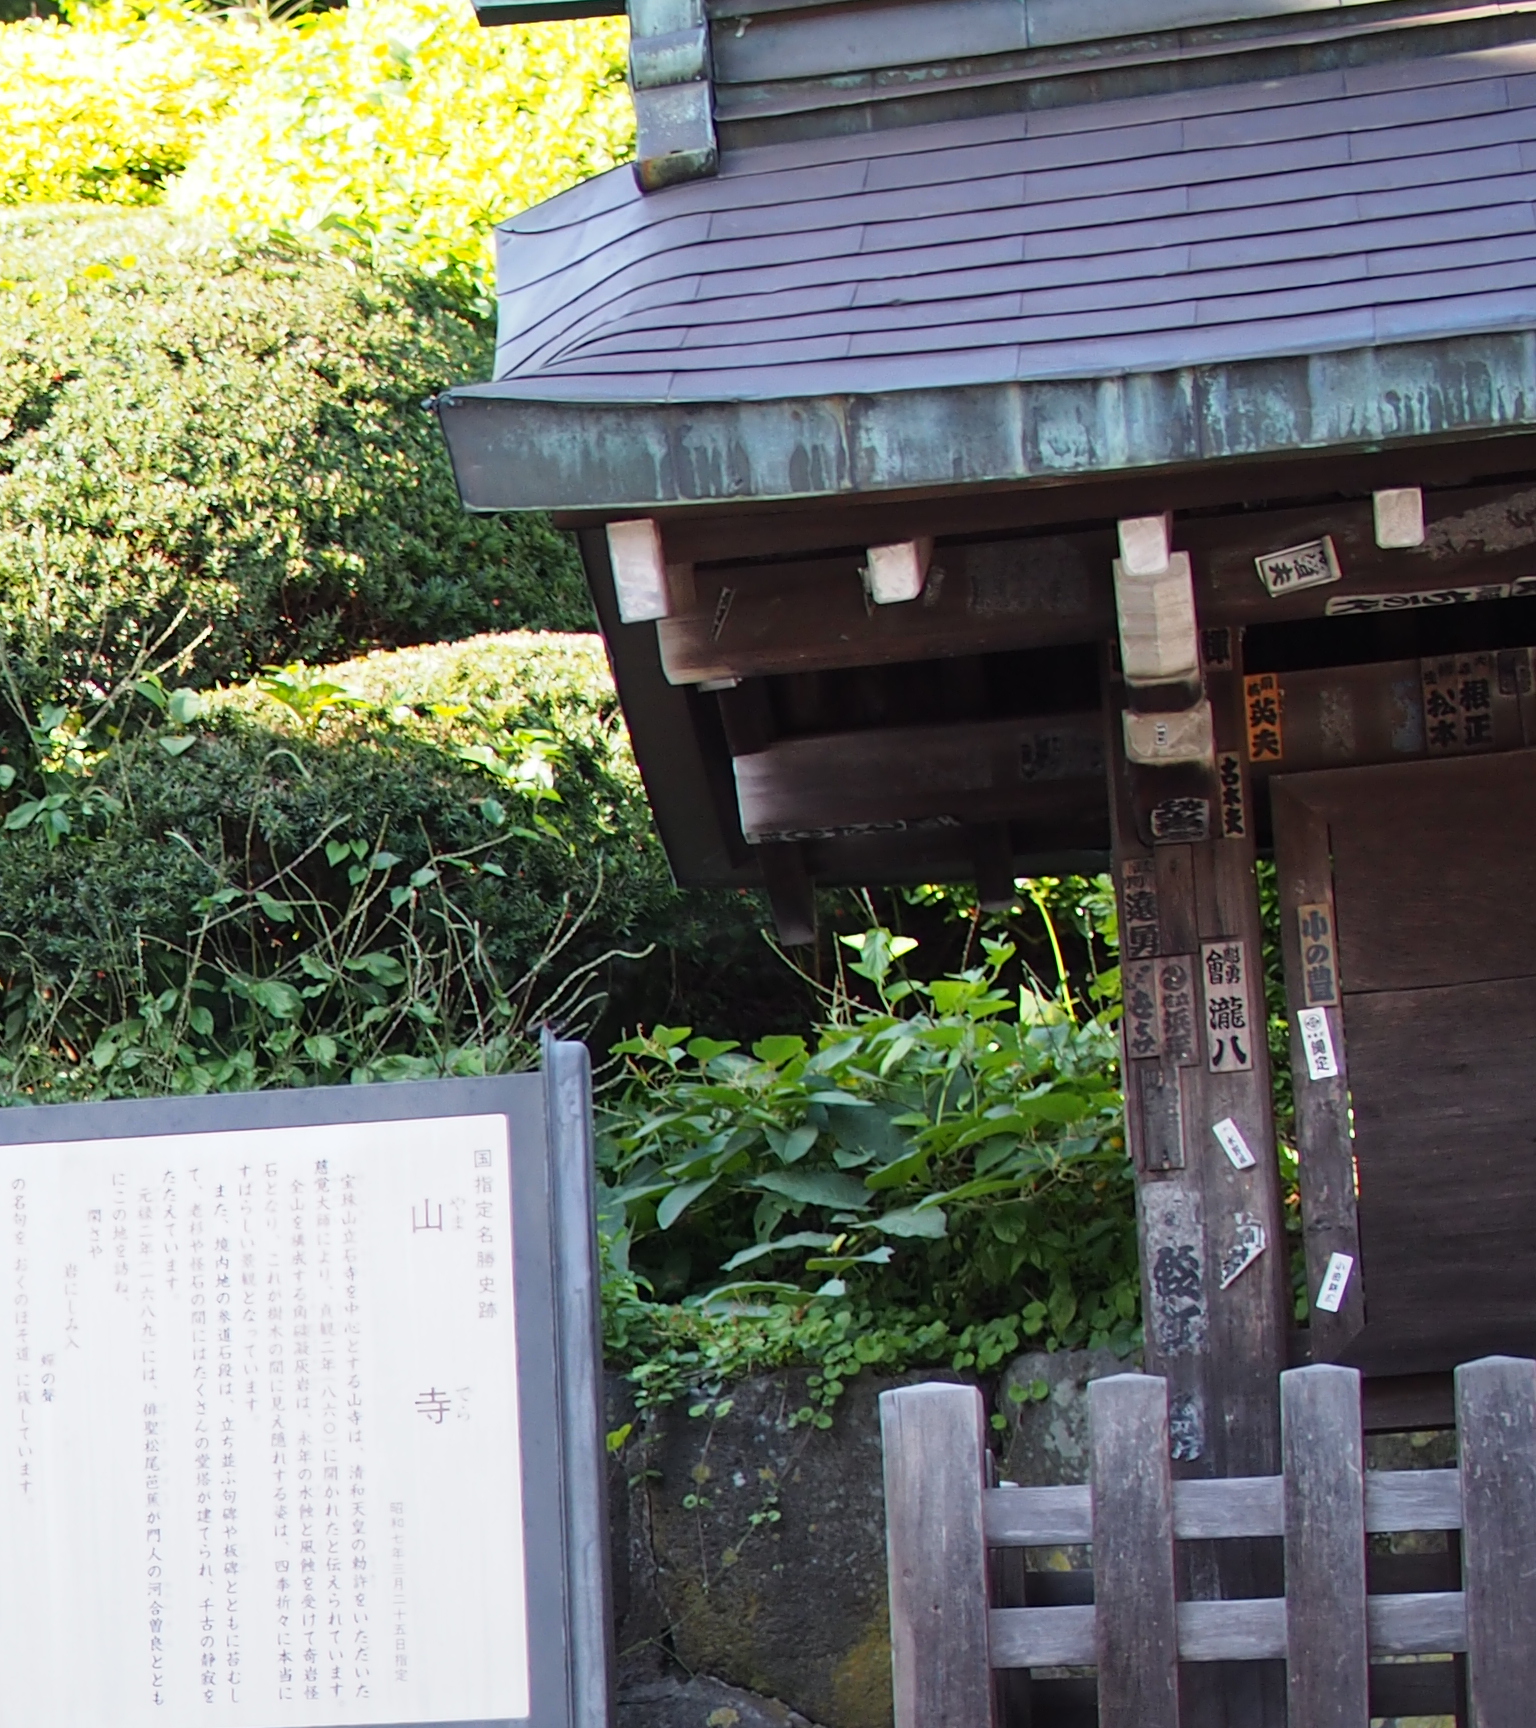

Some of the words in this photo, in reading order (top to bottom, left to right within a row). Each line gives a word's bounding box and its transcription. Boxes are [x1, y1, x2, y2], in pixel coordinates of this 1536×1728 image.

[87, 1209, 103, 1260] 閑さや
[112, 1172, 131, 1302] にこの地を訪ね、
[162, 1169, 180, 1301] たたえています。
[411, 1197, 444, 1234] 山
[449, 1196, 466, 1231] やま
[474, 1149, 498, 1319] 国指定名勝史跡
[64, 1262, 80, 1350] 岩にしみ入
[414, 1386, 452, 1425] 寺
[456, 1385, 474, 1422] てら
[389, 1501, 408, 1683] 昭和七年三月二十五日指定
